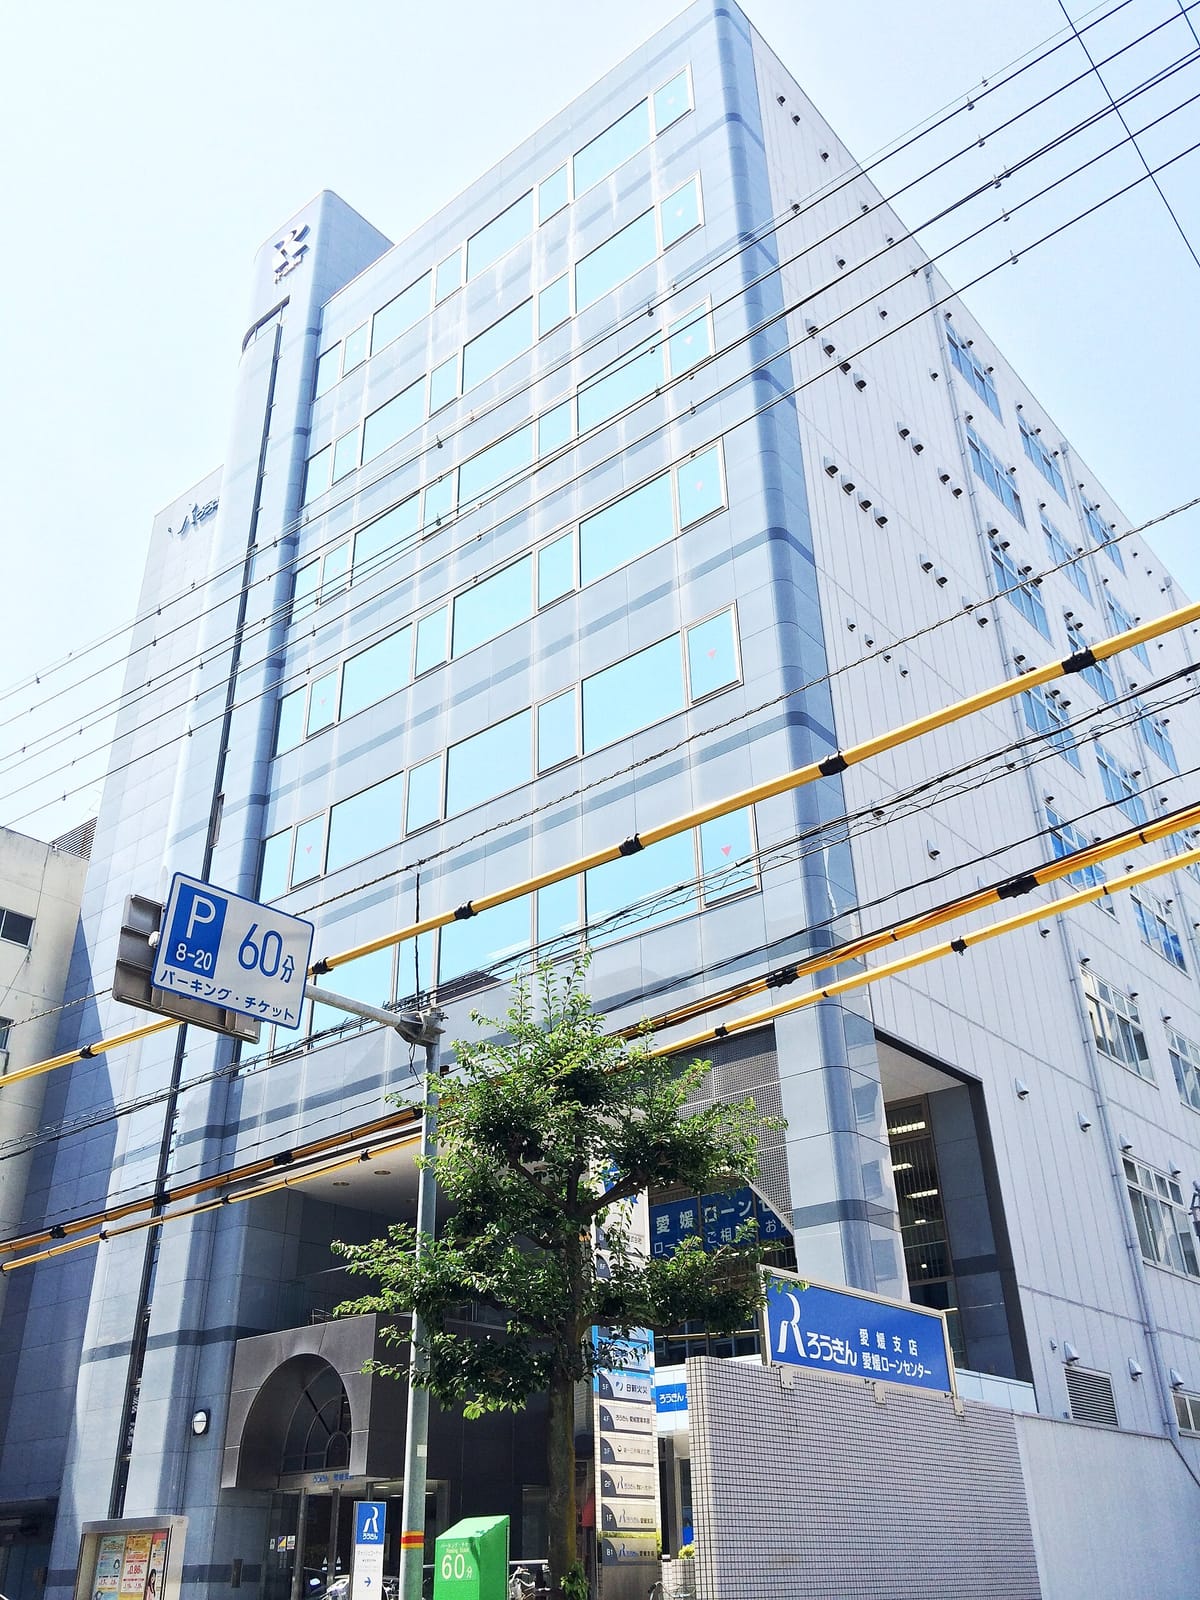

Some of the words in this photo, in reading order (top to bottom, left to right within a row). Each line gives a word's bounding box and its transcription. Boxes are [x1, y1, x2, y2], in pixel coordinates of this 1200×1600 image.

[186, 895, 216, 939] P
[175, 942, 213, 971] 8-20
[238, 923, 295, 983] 60分
[806, 1332, 857, 1367] ろうきん
[859, 1328, 918, 1357] 愛媛支店
[862, 1352, 932, 1379] 愛媛ローンセンター
[659, 1392, 684, 1404] ろうきん
[441, 1553, 473, 1580] 60分
